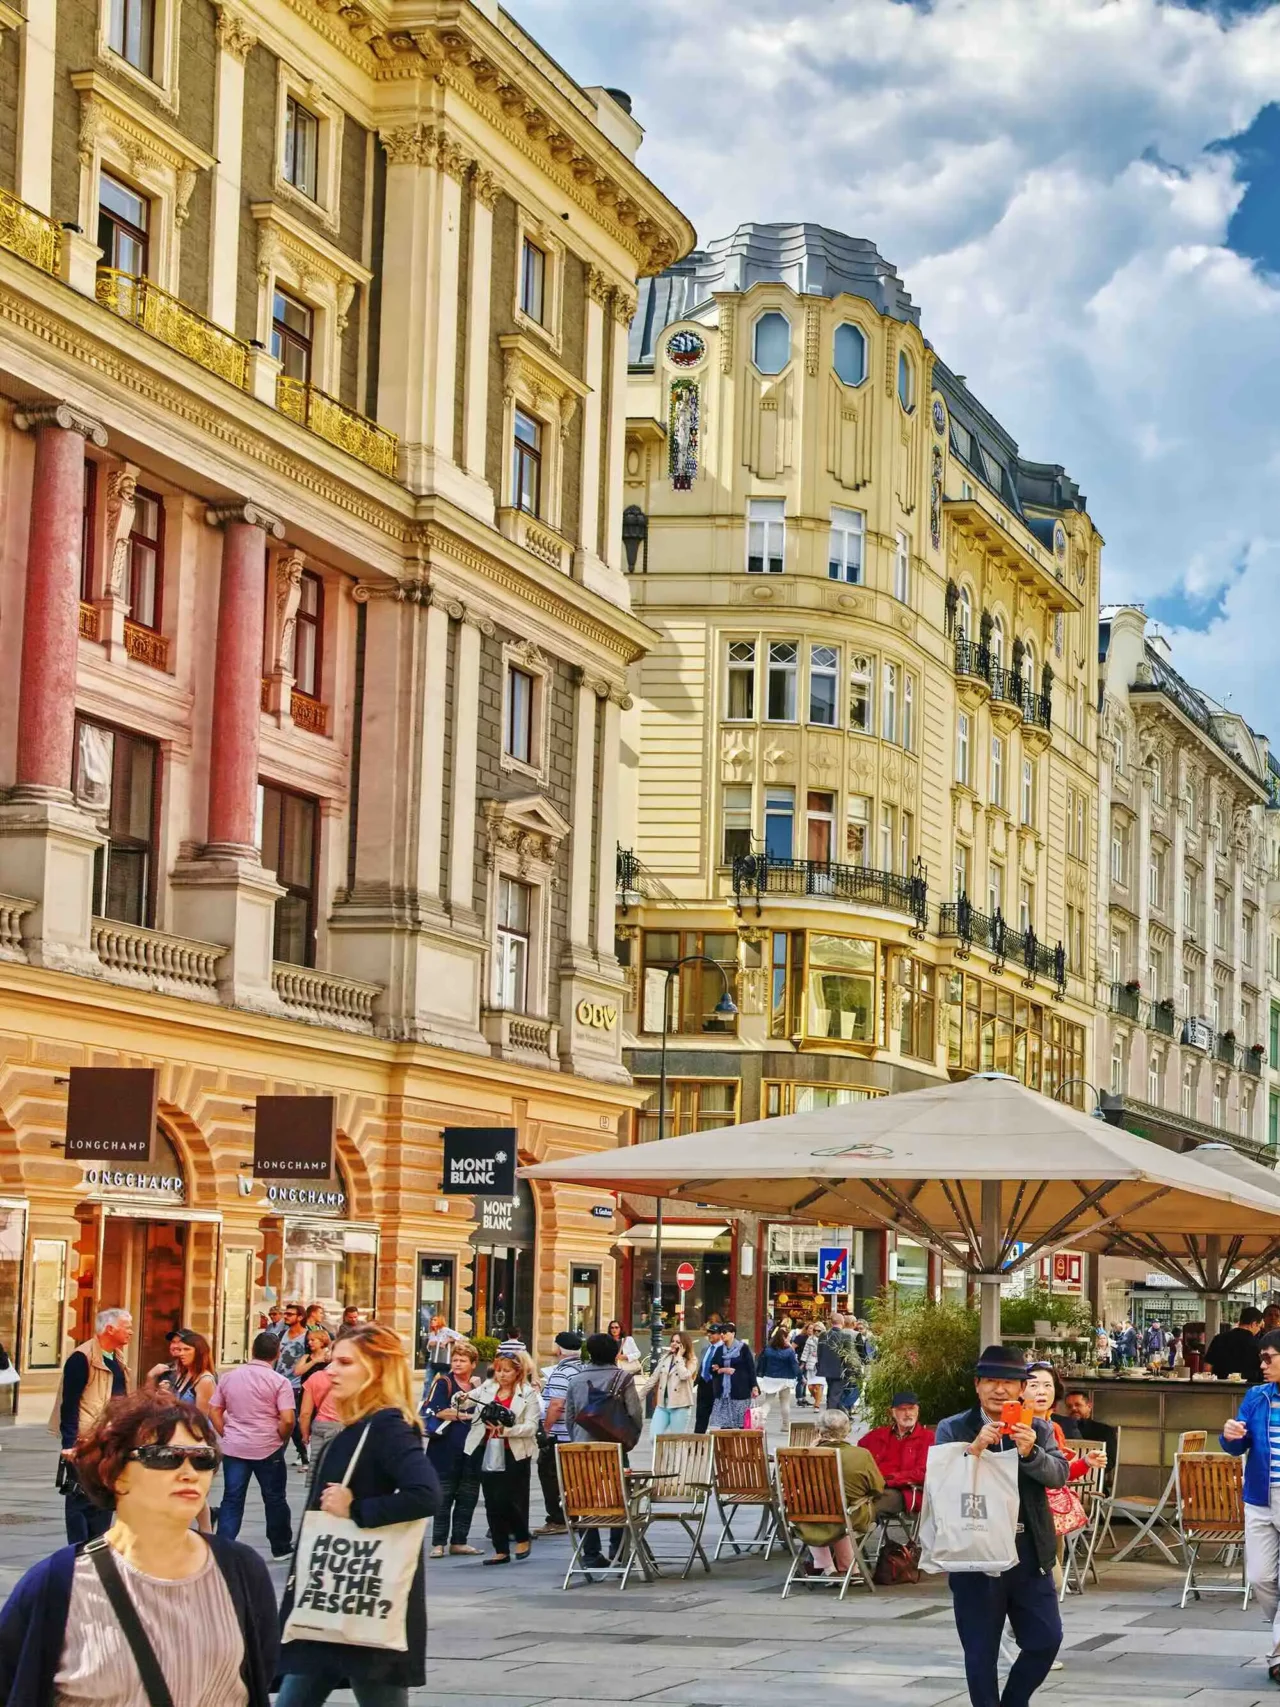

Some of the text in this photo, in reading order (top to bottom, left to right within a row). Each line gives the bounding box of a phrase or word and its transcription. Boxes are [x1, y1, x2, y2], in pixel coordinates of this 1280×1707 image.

[69, 1140, 146, 1151] LONGCHAMP
[257, 1160, 327, 1170] LONGCHAMP
[450, 1158, 495, 1172] MONT
[89, 1169, 182, 1191] ONGCHAMP
[450, 1172, 495, 1185] BLANC
[268, 1186, 344, 1206] ONGCHAMP
[483, 1201, 512, 1217] MONT
[483, 1215, 512, 1231] BLANC
[312, 1534, 383, 1558] HOW
[310, 1553, 383, 1576] MUCH
[333, 1574, 383, 1597] THE
[297, 1589, 393, 1620] FESCH?
